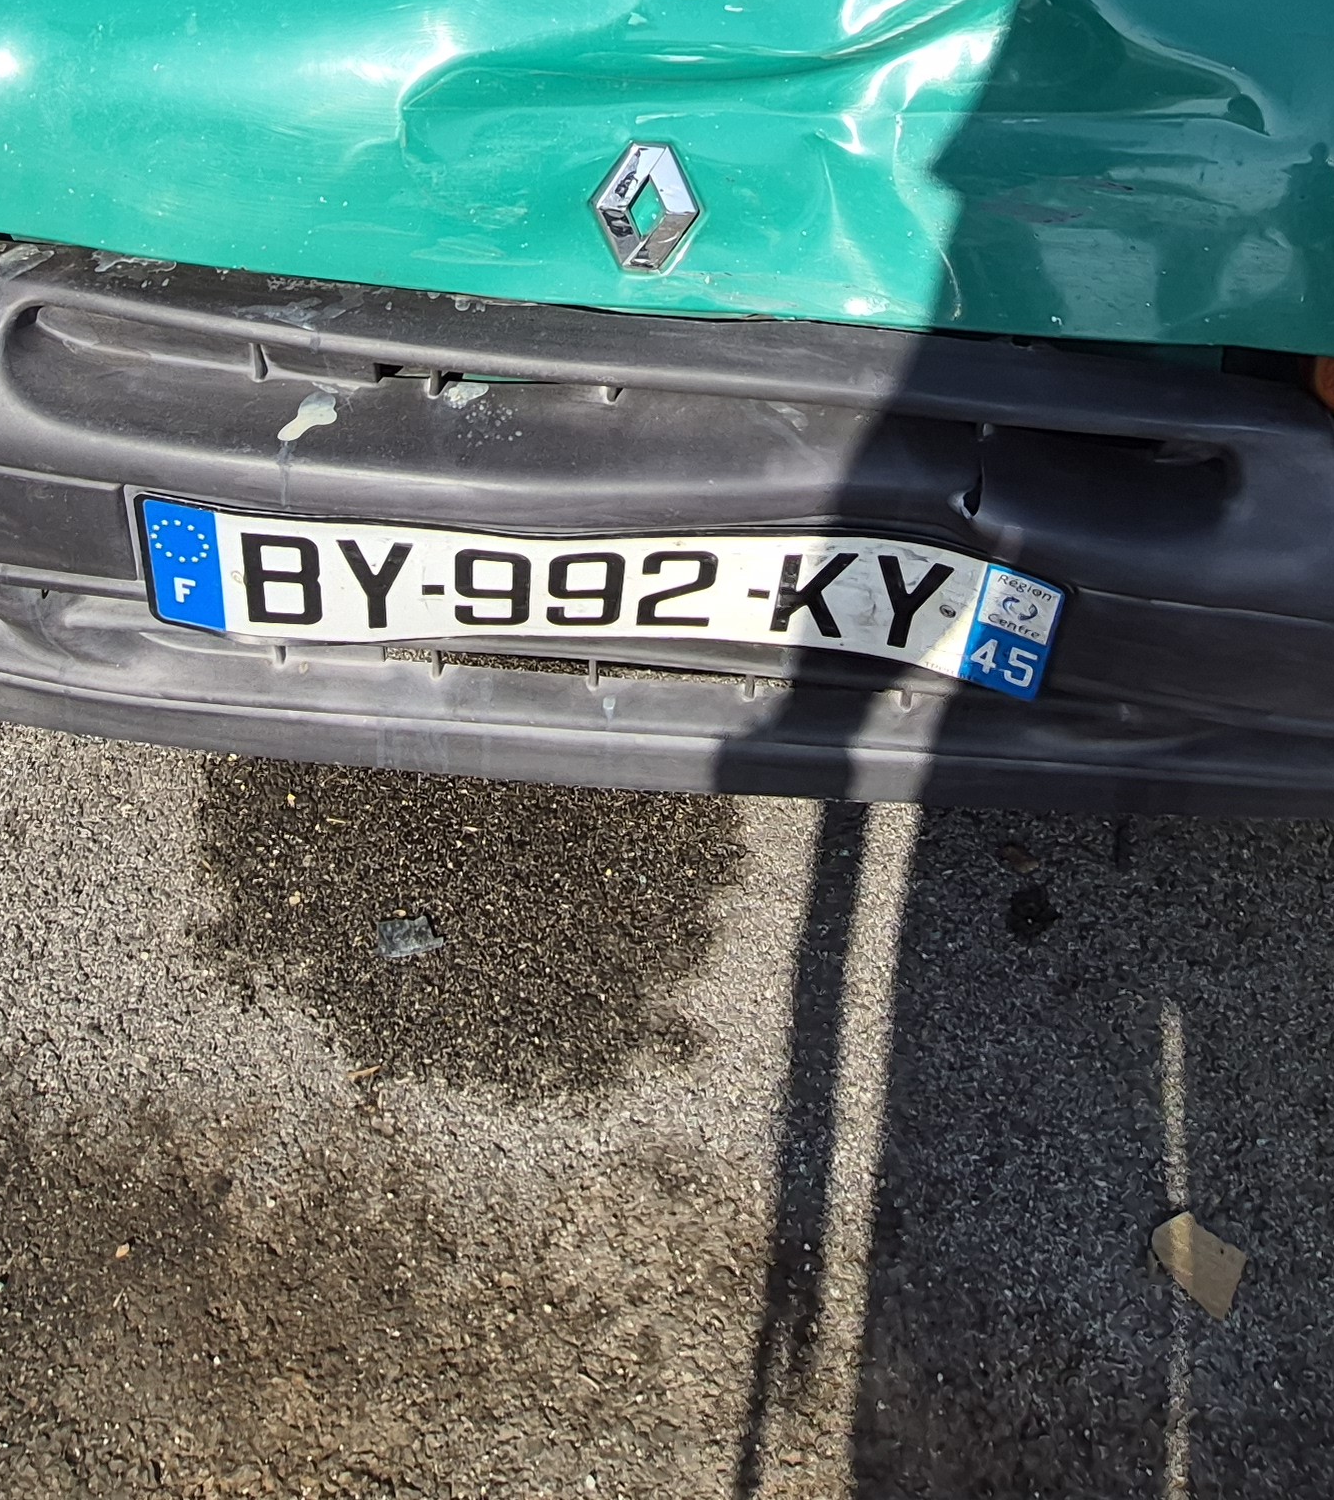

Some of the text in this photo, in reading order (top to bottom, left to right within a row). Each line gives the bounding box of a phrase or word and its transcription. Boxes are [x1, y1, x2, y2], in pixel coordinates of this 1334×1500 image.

[173, 577, 196, 603] F
[241, 532, 954, 648] BY-992-KY
[997, 574, 1052, 602] Région
[987, 613, 1041, 639] Centre
[970, 638, 1038, 688] 45
